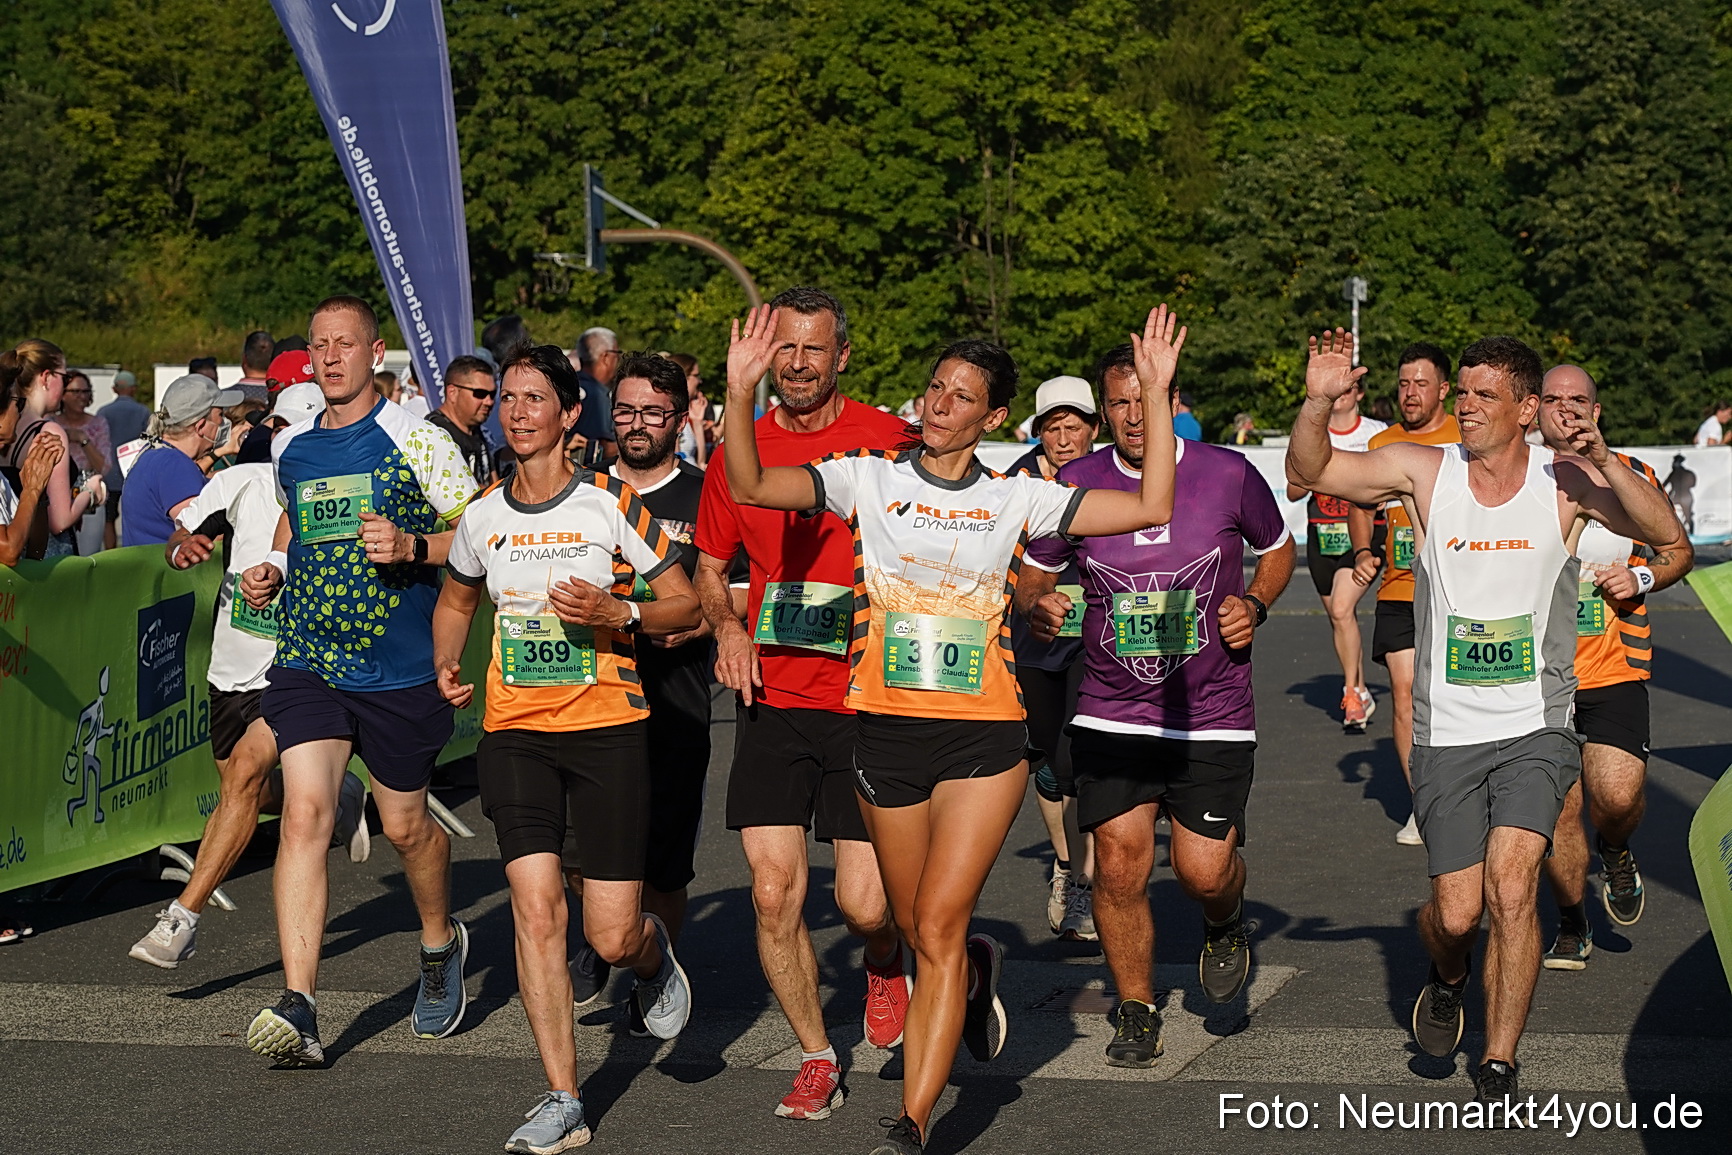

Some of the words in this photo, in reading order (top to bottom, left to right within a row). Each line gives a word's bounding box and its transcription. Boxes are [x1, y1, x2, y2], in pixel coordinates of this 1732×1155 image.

[313, 497, 352, 521] 692
[307, 522, 340, 532] Graubaum
[340, 519, 362, 527] Henry
[912, 516, 996, 532] DYNAMICS
[511, 531, 590, 547] KLEBL
[1326, 533, 1349, 545] 252
[1469, 539, 1535, 551] KLEBL
[509, 545, 589, 563] DYNAMICS
[233, 598, 241, 618] RUN
[241, 598, 281, 623] 196
[775, 602, 836, 629] 1709
[1593, 602, 1601, 628] 2022
[240, 614, 259, 627] Brandl
[761, 609, 773, 632] RUN
[834, 613, 847, 645] 2022
[1126, 612, 1181, 636] 1541
[1185, 615, 1194, 645] 2022
[794, 627, 830, 639] Raphael
[1118, 622, 1126, 644] RUN
[1127, 637, 1147, 645] Klebl
[149, 631, 181, 661] Fischer
[523, 640, 571, 664] 369
[1450, 646, 1459, 670] RUN
[1466, 641, 1514, 665] 406
[1522, 641, 1532, 672] 2022
[506, 647, 516, 672] RUN
[515, 664, 547, 674] Falkner
[548, 664, 582, 674] Daniela
[581, 643, 592, 675] 2022
[888, 645, 898, 672] RUN
[967, 649, 980, 684] 2022
[1457, 664, 1492, 673] Dirnhofer
[1492, 663, 1524, 672] Andreas
[941, 668, 969, 678] Claudia
[111, 684, 210, 784] firmenla
[111, 766, 168, 813] neumarkt
